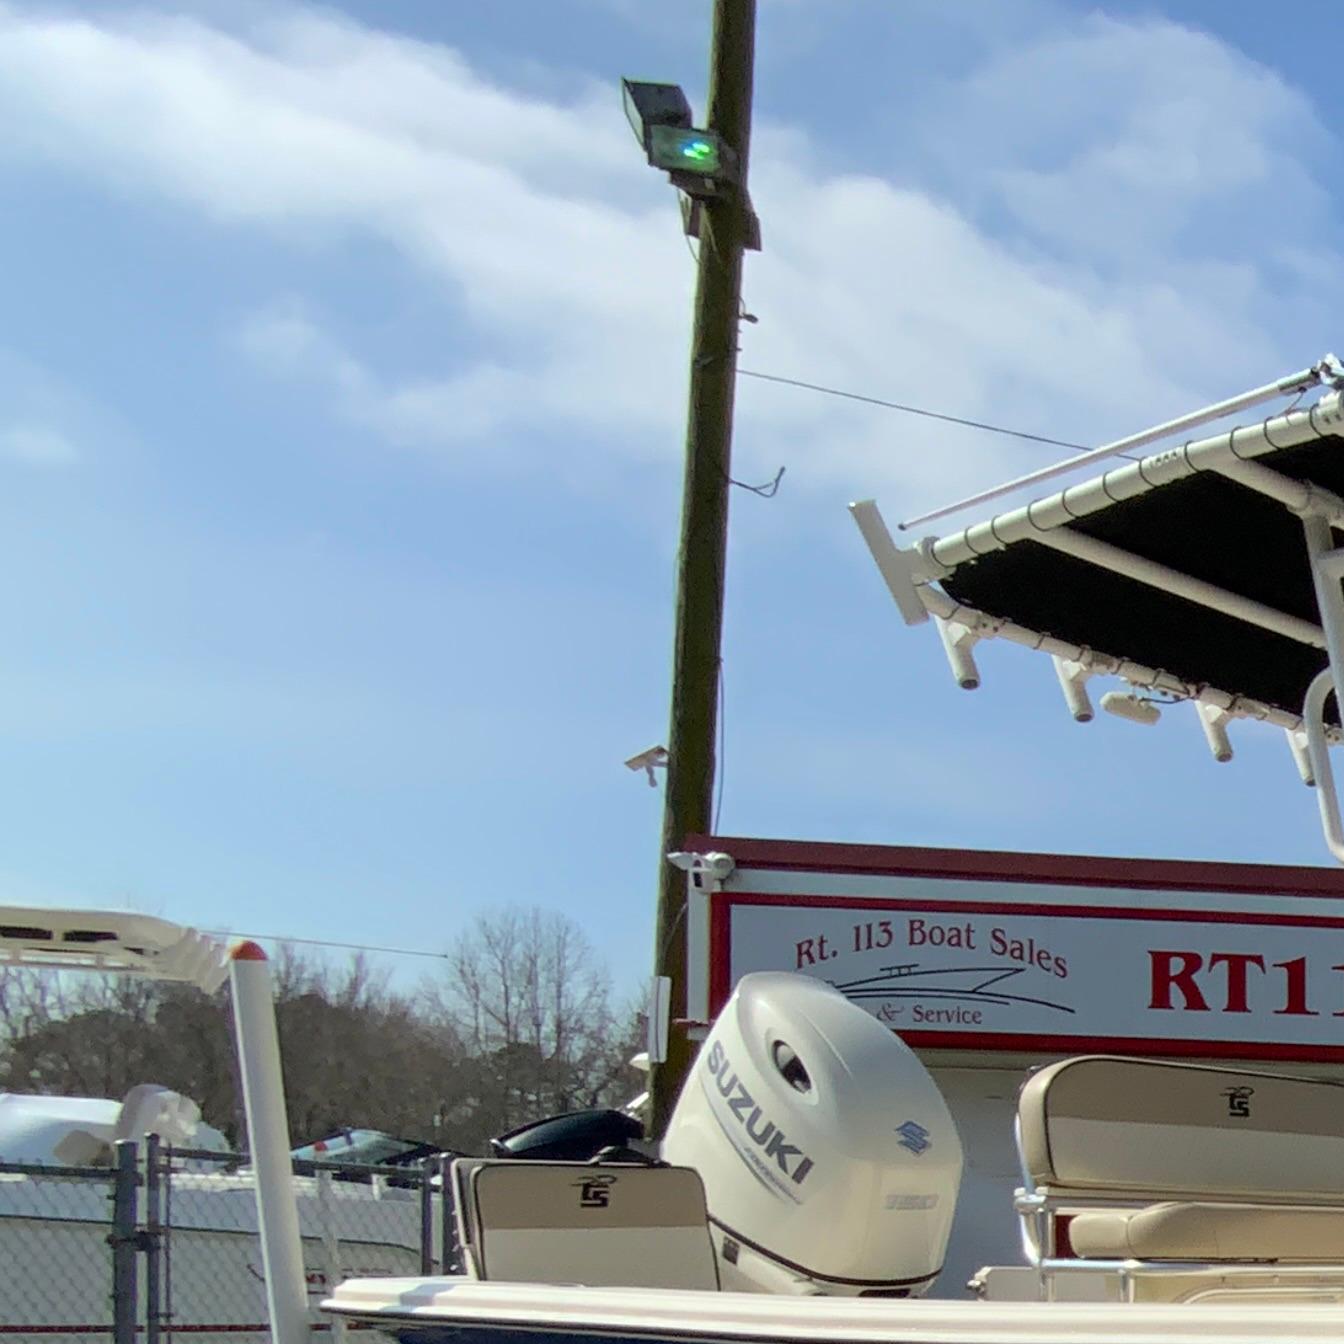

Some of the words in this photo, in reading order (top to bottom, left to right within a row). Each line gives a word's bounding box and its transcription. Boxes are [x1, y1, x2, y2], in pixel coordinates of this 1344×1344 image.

[795, 935, 838, 969] Rt.
[853, 920, 894, 951] 113
[908, 919, 977, 950] Boat
[990, 928, 1069, 979] Sales
[912, 1004, 982, 1025] Service
[707, 1040, 815, 1185] SUZUKI
